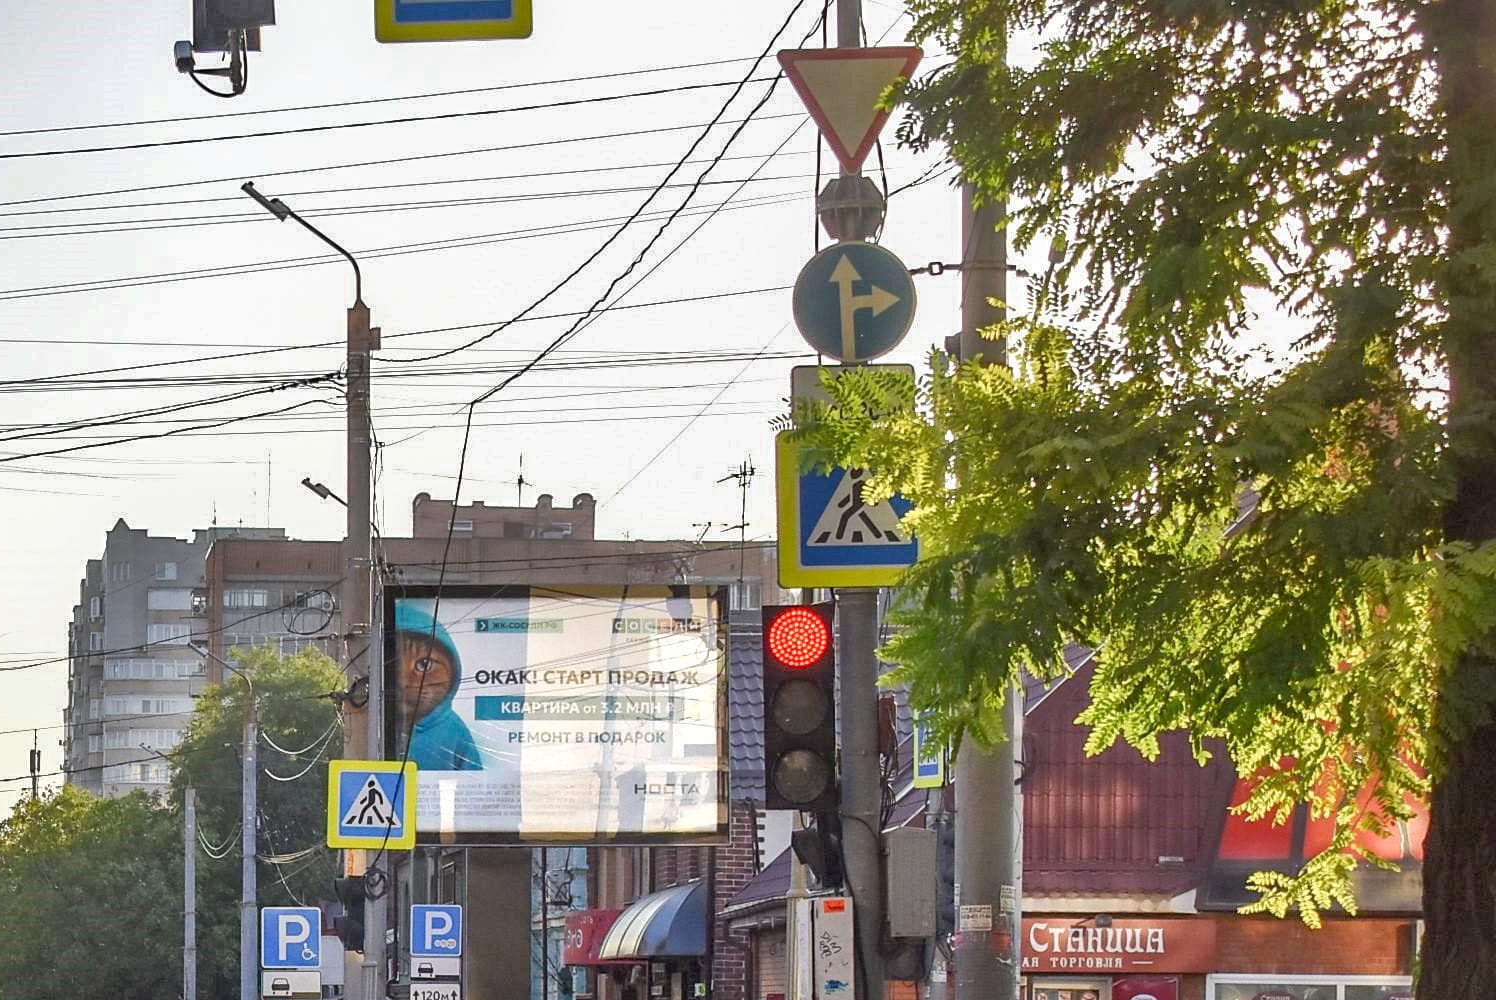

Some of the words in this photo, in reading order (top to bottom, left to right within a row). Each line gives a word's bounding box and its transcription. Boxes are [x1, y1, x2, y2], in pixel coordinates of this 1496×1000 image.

[474, 669, 537, 685] ОКАК!
[543, 669, 603, 685] СТАРТ
[608, 670, 700, 687] ПРОДАЖ
[501, 701, 580, 714] КВАРТИРА
[508, 731, 571, 743] РЕМОНТ
[575, 731, 584, 743] В
[588, 731, 665, 746] ПОДАРОК
[1050, 957, 1123, 968] ТОРГОВЛЯ
